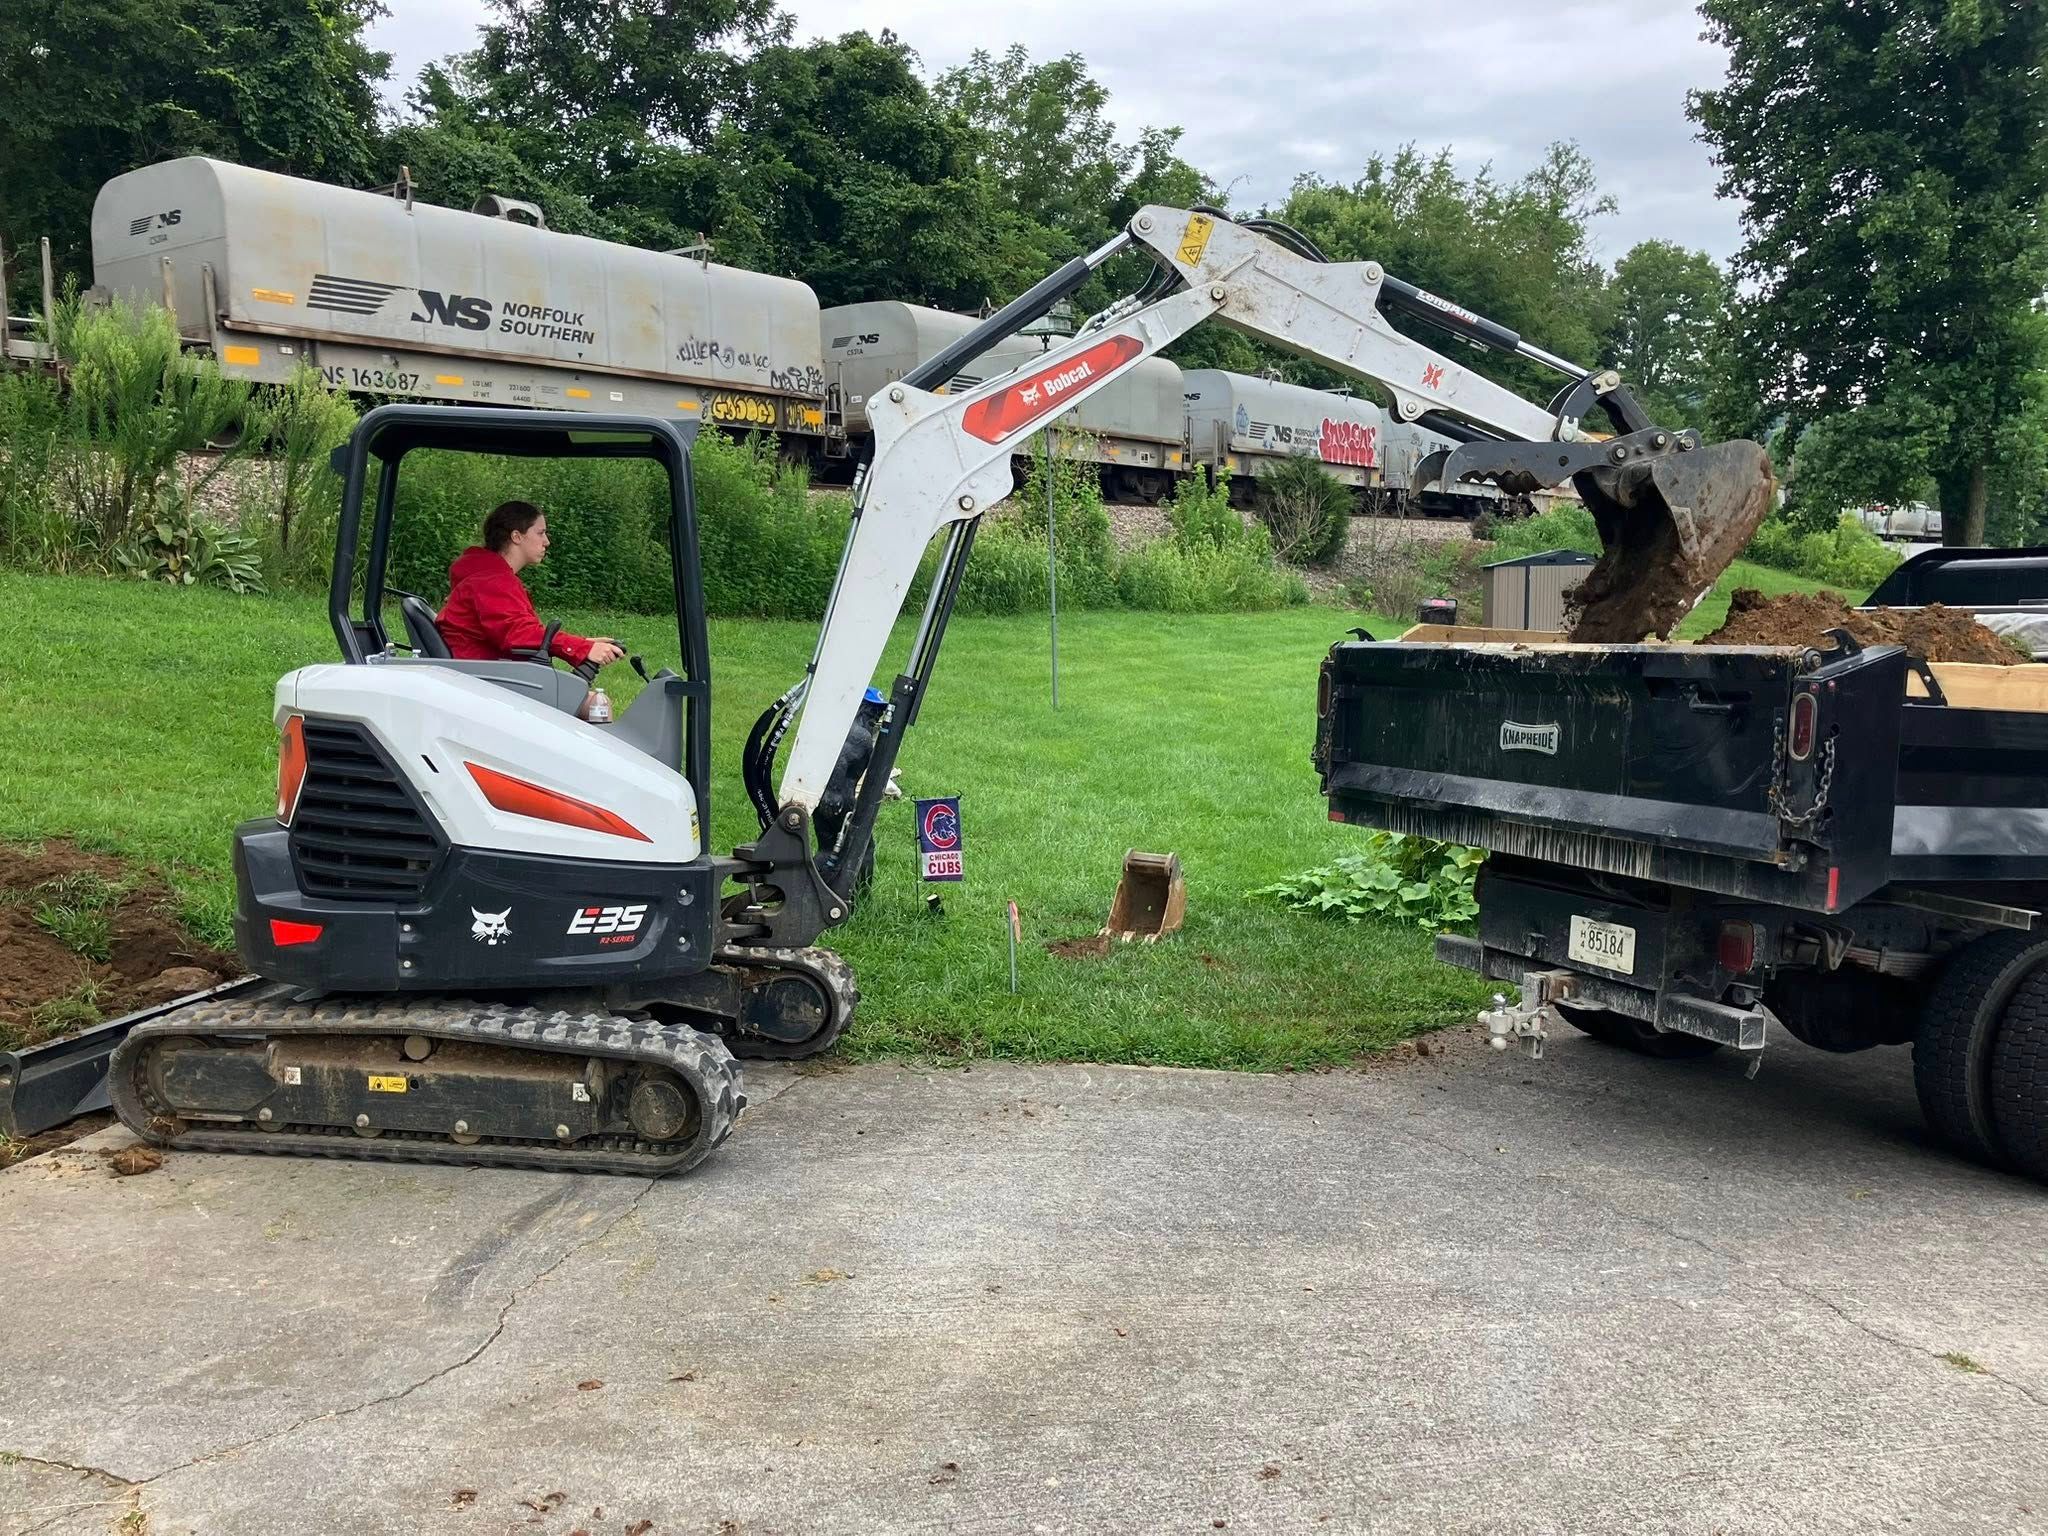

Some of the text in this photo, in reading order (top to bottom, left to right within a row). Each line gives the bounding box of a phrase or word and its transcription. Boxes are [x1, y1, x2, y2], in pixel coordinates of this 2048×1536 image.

[157, 209, 182, 228] NS
[410, 290, 493, 331] NS
[502, 302, 585, 326] NORFOLK
[499, 318, 595, 345] SOUTHERN
[856, 333, 880, 346] NS
[319, 366, 420, 391] NS 163687
[1042, 360, 1093, 397] Bobcat
[1183, 392, 1203, 404] NS
[1271, 425, 1293, 443] NS
[1502, 728, 1555, 750] KNAPHEIDE
[929, 852, 959, 861] CHICAGO
[928, 861, 961, 875] CUBS
[566, 904, 648, 934] E35
[600, 935, 636, 944] R2-SERIES
[1588, 930, 1624, 958] 85184
